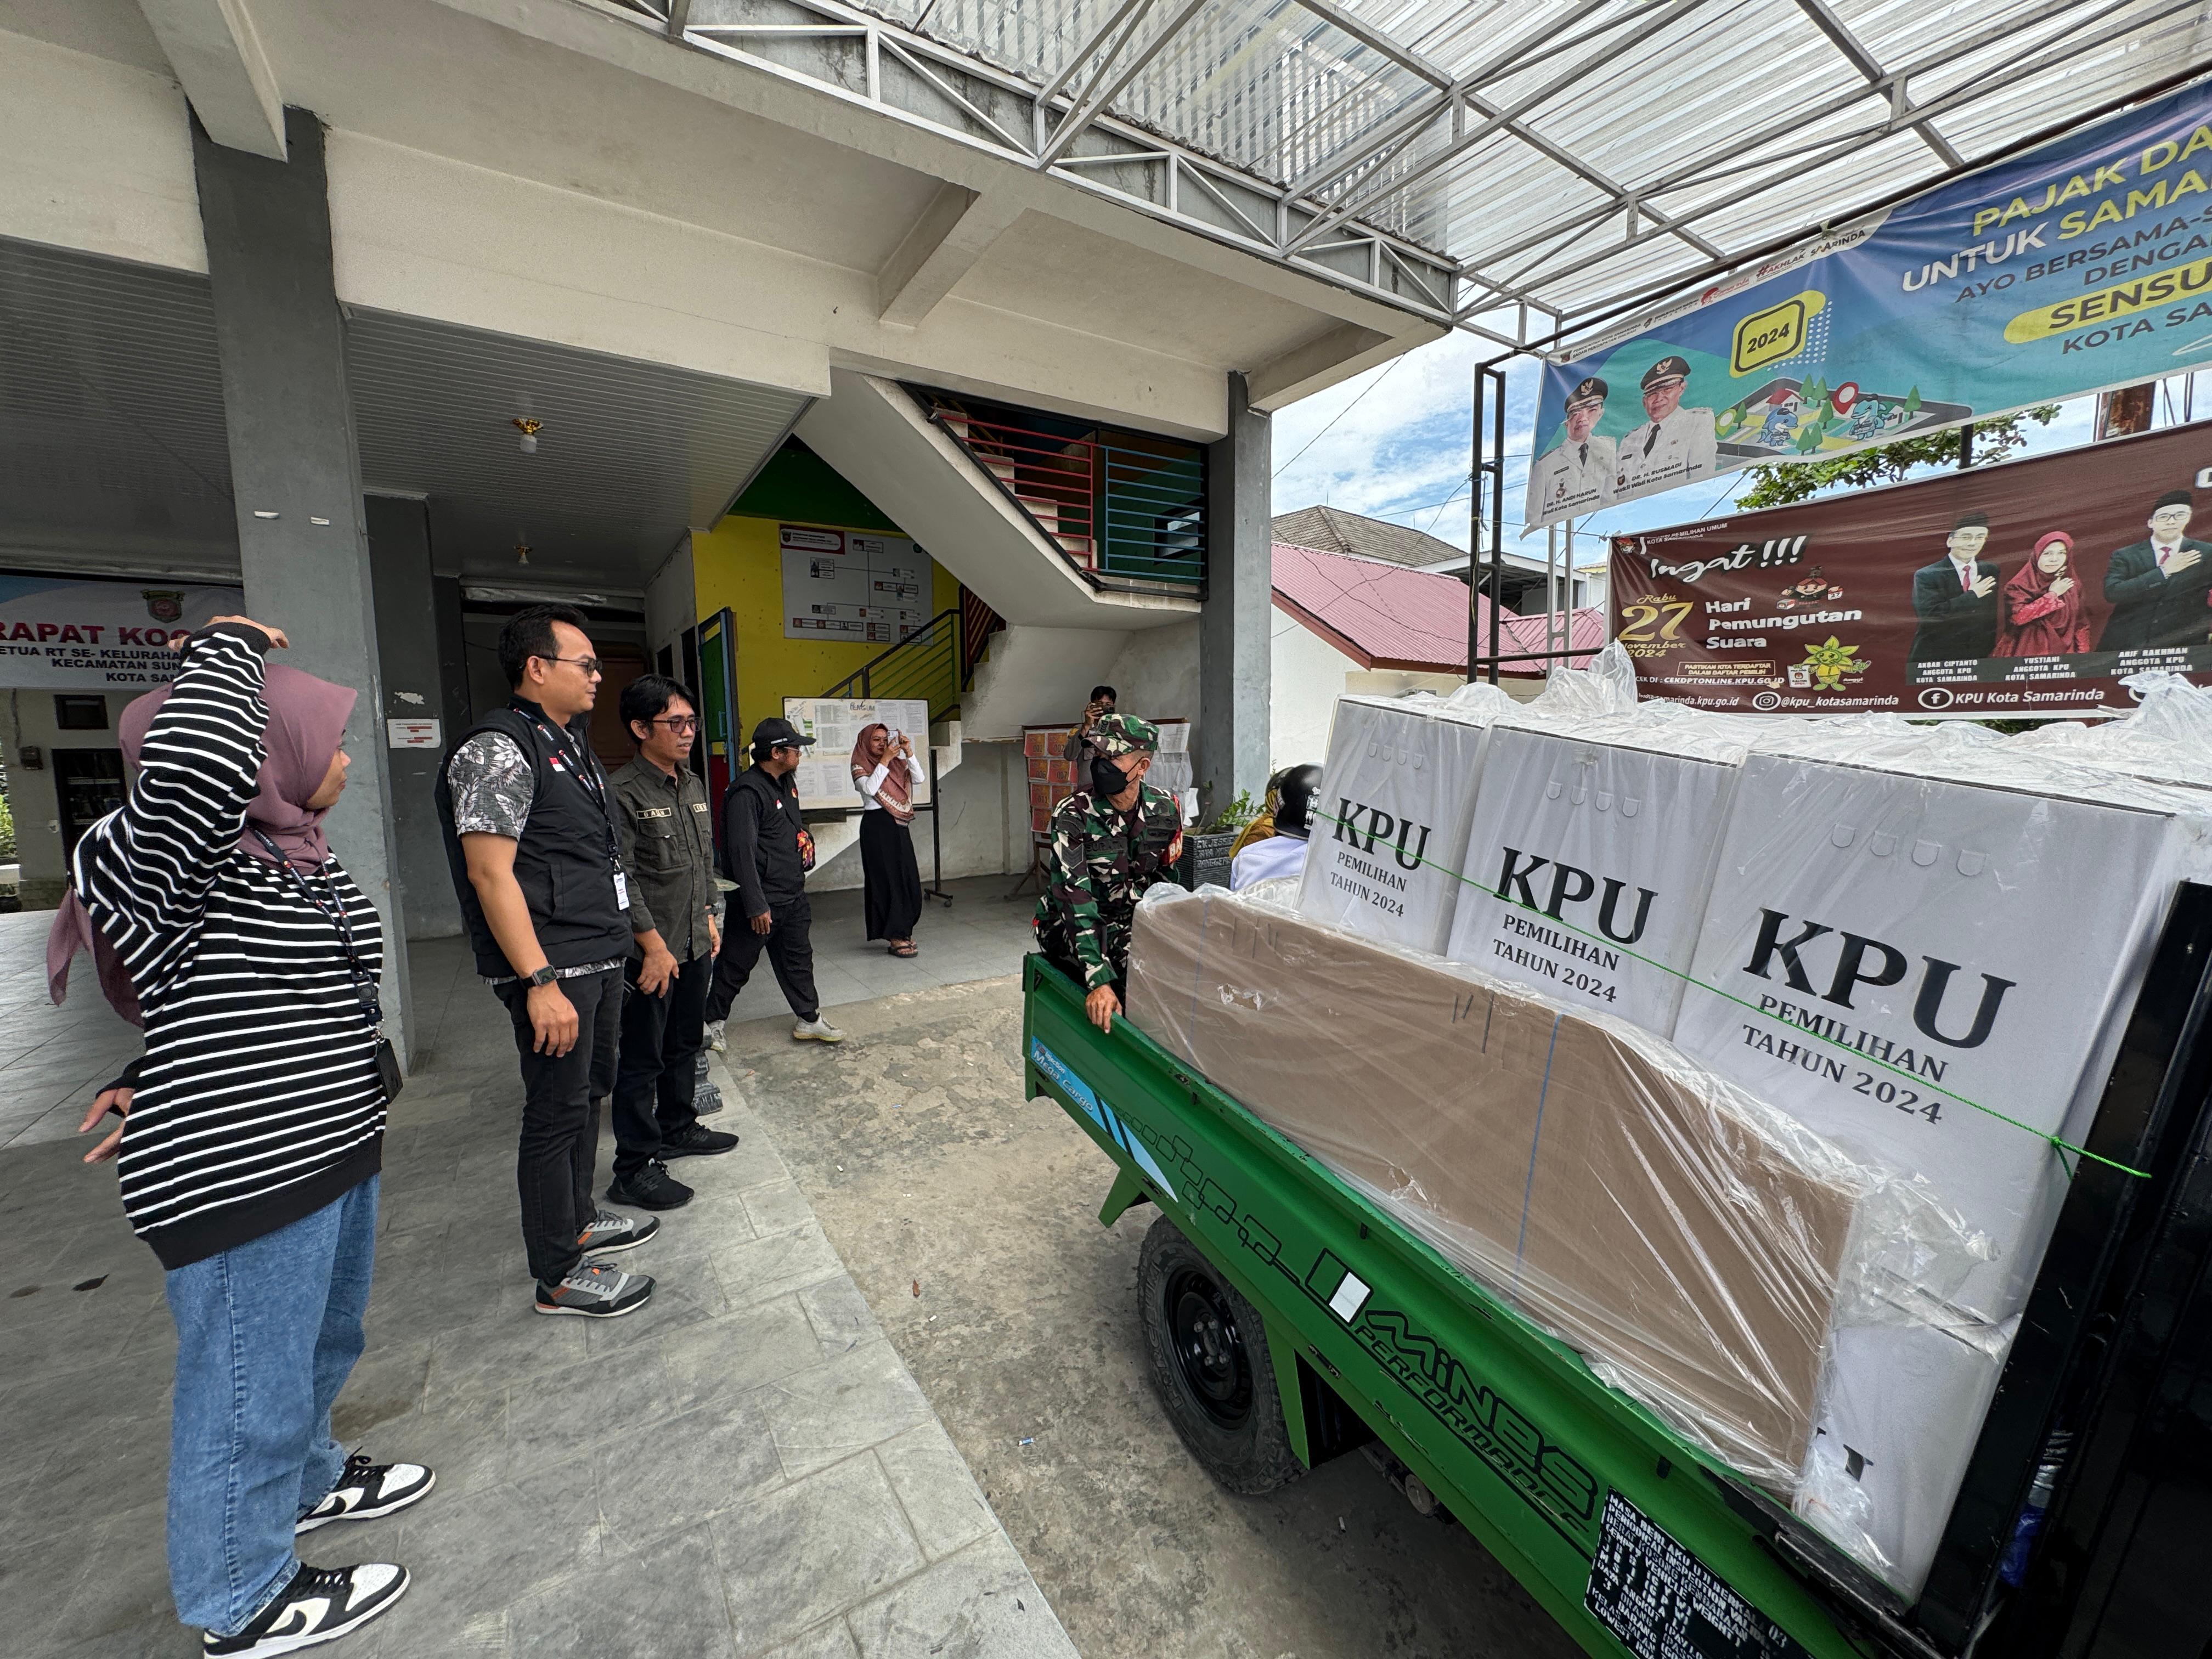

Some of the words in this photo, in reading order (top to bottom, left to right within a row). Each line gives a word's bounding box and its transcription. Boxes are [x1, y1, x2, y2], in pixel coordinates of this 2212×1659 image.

[1972, 157, 2129, 237] PAJAK
[1902, 223, 2050, 291] UNTUK
[1955, 274, 2016, 303] AYO
[1747, 323, 1790, 354] 2024
[2062, 318, 2155, 354] KOTA
[1613, 483, 1630, 494] Wakil
[1646, 476, 1662, 485] Kota
[1663, 462, 1702, 479] Samarinda
[1554, 504, 1567, 512] Kota
[1568, 494, 1600, 509] Samarinda
[1707, 523, 1728, 532] UMUM
[1651, 544, 1756, 583] Ingat
[1636, 593, 1677, 603] Rabu
[1705, 597, 1751, 613] Hari
[1618, 601, 1694, 641] 27
[1708, 609, 1863, 629] Pemungutan
[46, 647, 66, 657] RT
[1706, 636, 1768, 650] Suara
[2120, 658, 2160, 667] ANGGOTA
[2142, 647, 2188, 657] RAKHMAN
[52, 658, 147, 670] KECAMATAN
[106, 673, 145, 682] KOTA
[2029, 672, 2076, 680] SAMARINDA
[1781, 694, 1899, 709] @kpu_kotasamarinda
[1955, 693, 1983, 704] KPU
[1987, 692, 2019, 703] Kota
[2022, 689, 2105, 703] Samarinda
[1331, 797, 1431, 871] KPU
[1336, 851, 1407, 893] PEMILIHAN
[1330, 872, 1372, 904] TAHUN
[1373, 892, 1404, 918] 2024
[1493, 846, 1658, 945] KPU
[1502, 913, 1620, 972] PEMILIHAN
[1493, 939, 1559, 979] TAHUN
[1564, 967, 1617, 1003] 2024
[1742, 907, 2017, 1049] KPU
[1759, 994, 1949, 1082] PEMILIHAN
[1034, 1051, 1059, 1080] Mega
[1063, 1079, 1093, 1111] Cargo
[1743, 1024, 1847, 1084] TAHUN
[1852, 1072, 1943, 1125] 2024
[1610, 1493, 1637, 1523] MASA
[1607, 1502, 1663, 1556] PERIODICAL
[1606, 1512, 1636, 1544] BERAT
[1638, 1539, 1679, 1581] KOSONG
[1679, 1575, 1749, 1643] KENDARAAN
[1644, 1555, 1688, 1600] VEHICLE
[1591, 1587, 1622, 1621] KELAS
[1594, 1600, 1632, 1643] LOWEST
[1602, 1576, 1612, 1592] 3
[1619, 1591, 1654, 1628] ORANG
[1621, 1582, 1661, 1623] ANGKUT
[1617, 1600, 1658, 1644] BARANG
